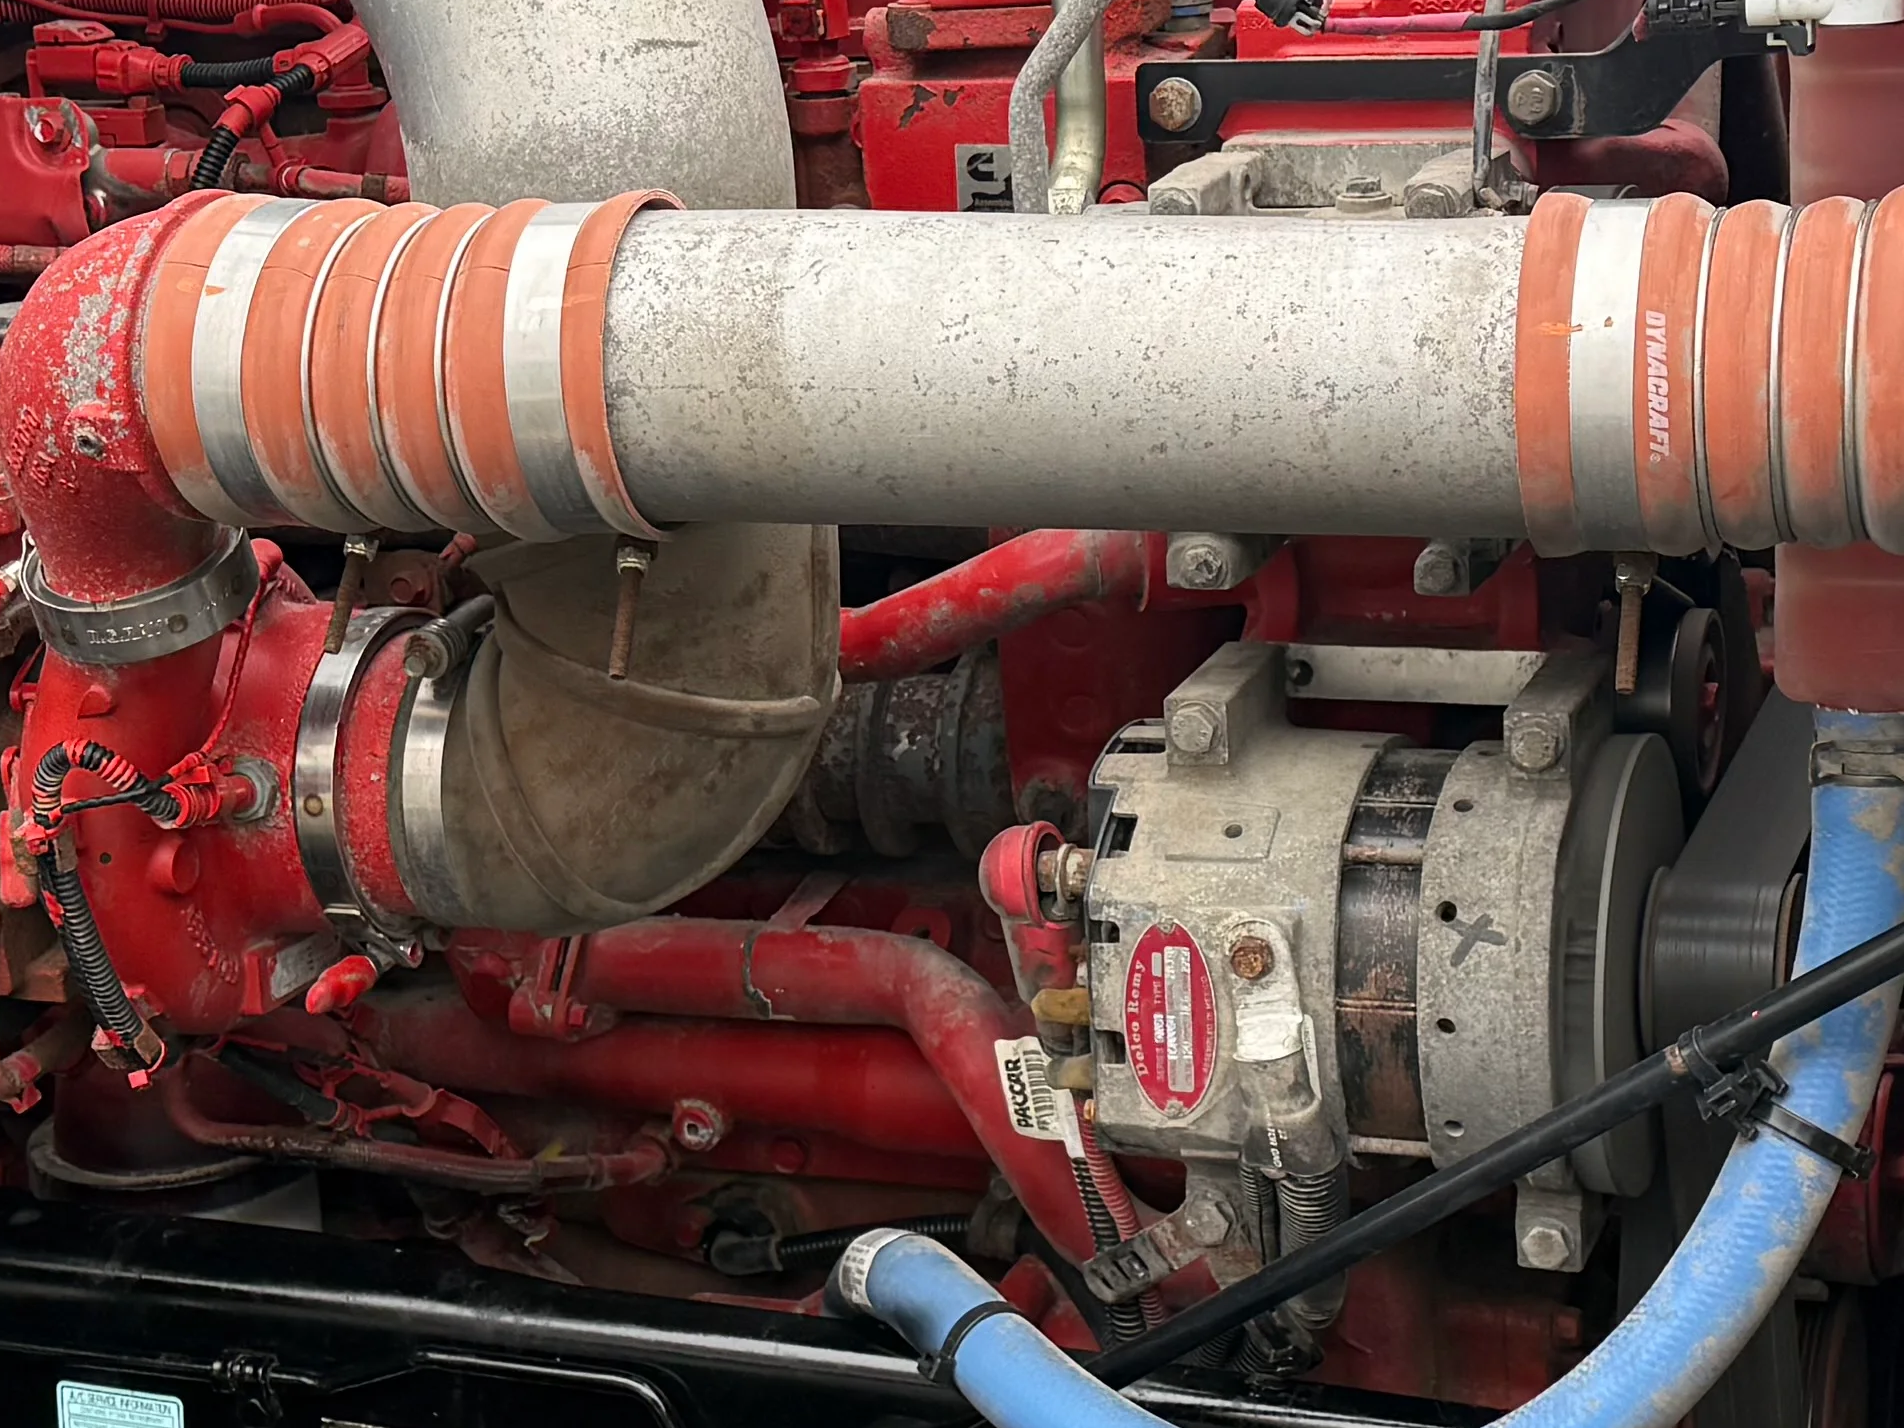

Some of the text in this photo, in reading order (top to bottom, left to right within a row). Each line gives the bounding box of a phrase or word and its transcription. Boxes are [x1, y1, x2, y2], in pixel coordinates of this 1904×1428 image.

[1127, 959, 1149, 1076] Delco Remy
[1004, 1057, 1034, 1128] PACCAR
